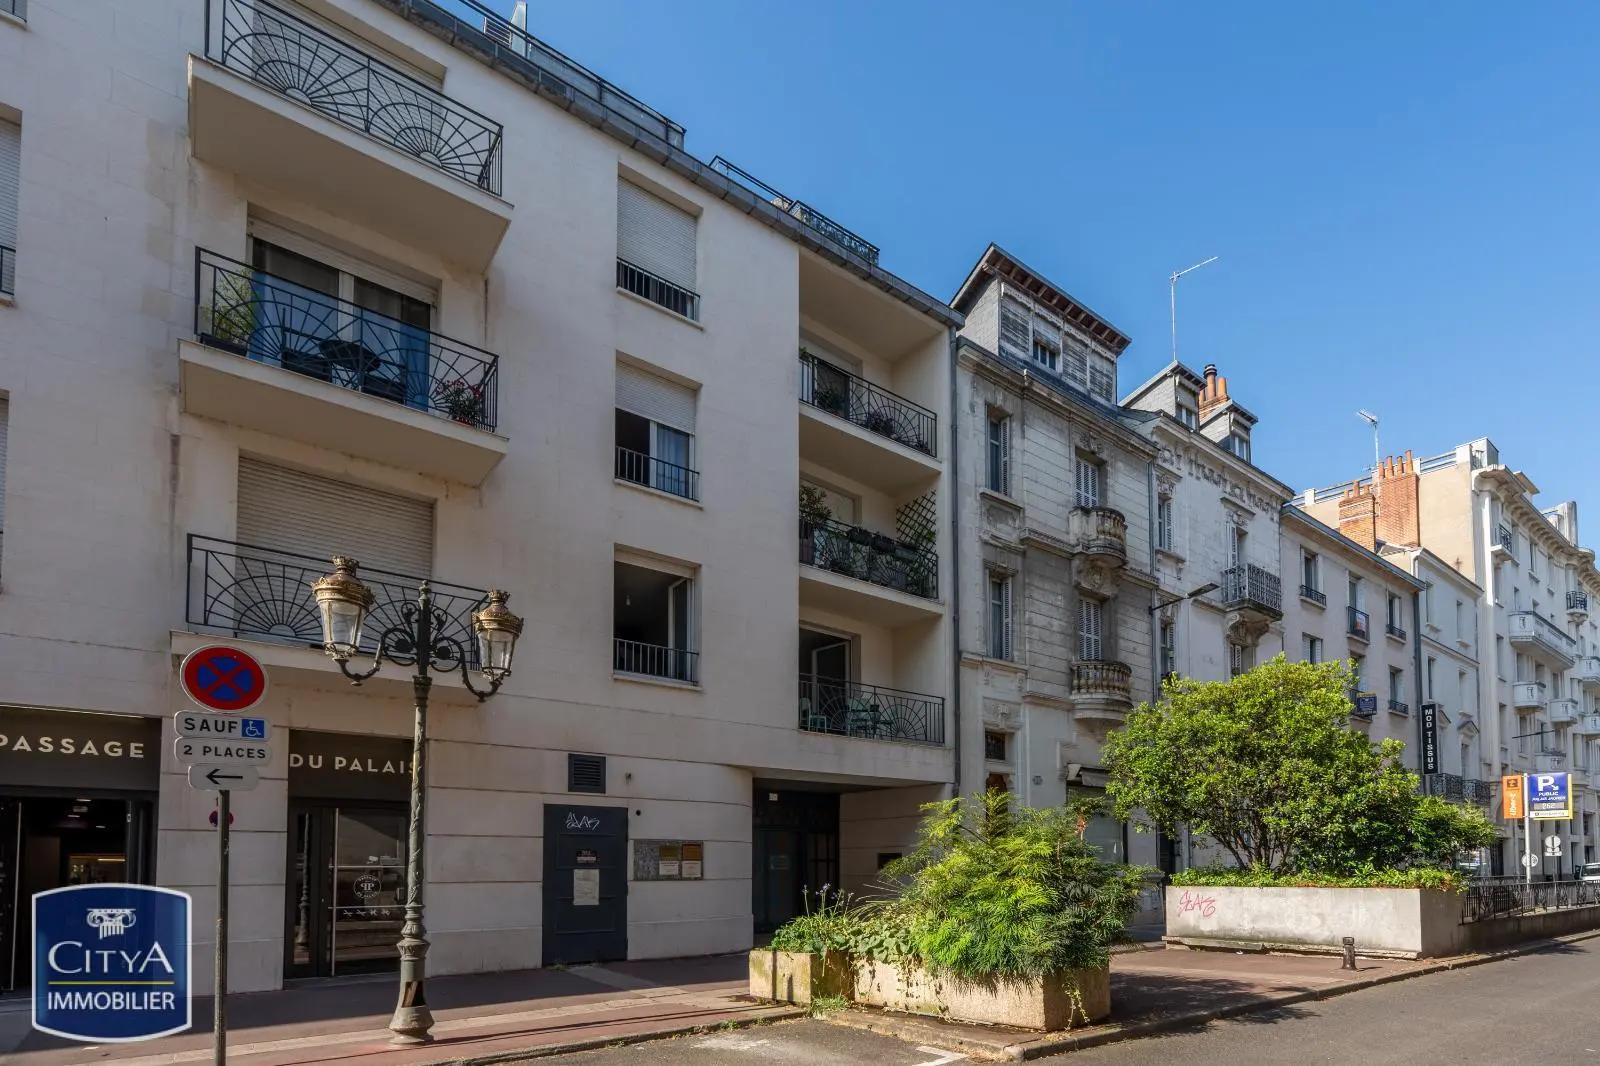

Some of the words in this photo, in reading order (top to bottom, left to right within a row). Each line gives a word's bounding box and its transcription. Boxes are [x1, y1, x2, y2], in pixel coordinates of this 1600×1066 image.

[184, 717, 238, 733] SAUF
[1424, 708, 1433, 728] MOD
[183, 745, 193, 755] 2
[202, 745, 266, 759] PLACES
[1426, 731, 1434, 770] TISSUS
[289, 753, 323, 769] DU
